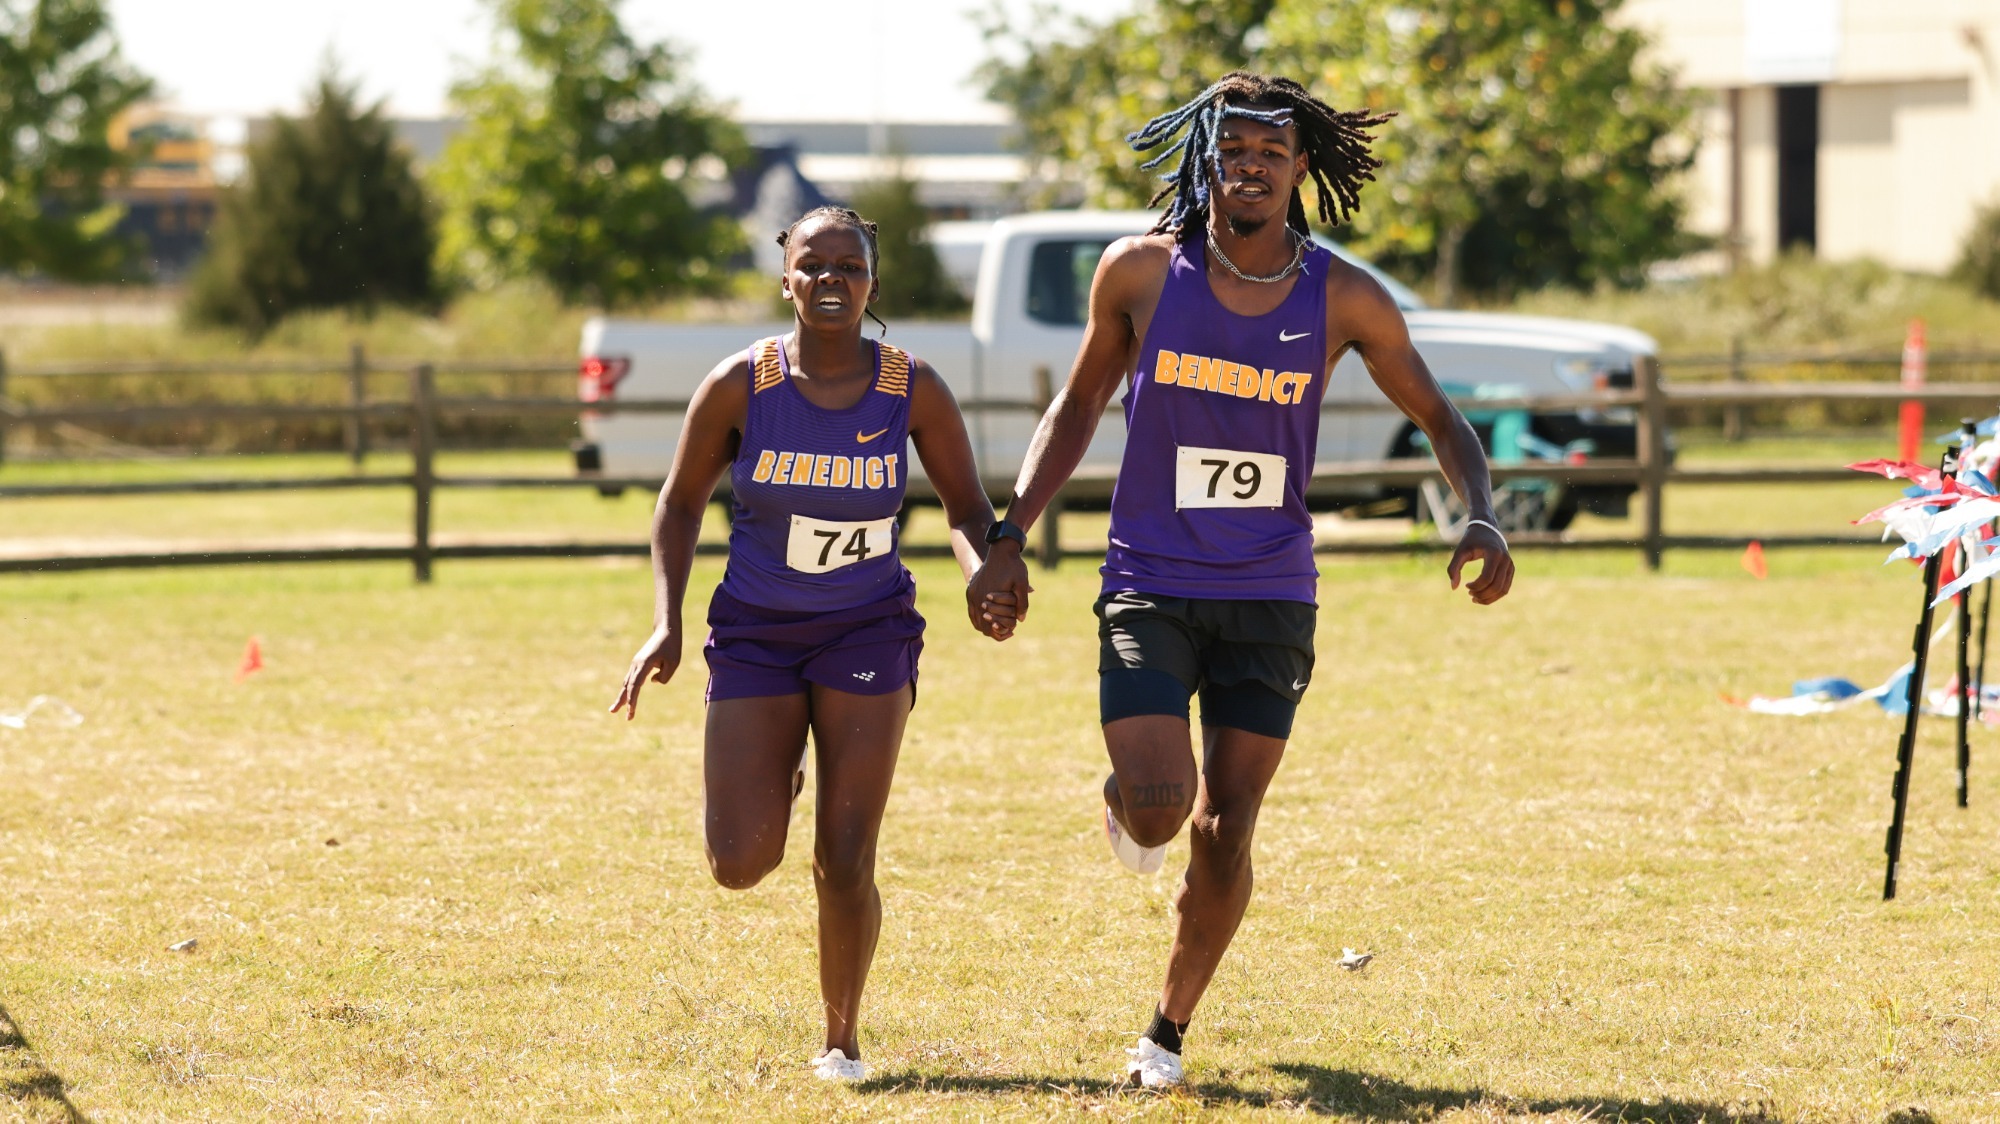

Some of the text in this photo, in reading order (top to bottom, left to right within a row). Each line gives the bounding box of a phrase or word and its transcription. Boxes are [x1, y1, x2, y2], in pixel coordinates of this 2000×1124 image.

[1154, 349, 1312, 405] BENEDICT
[752, 450, 898, 490] BENEDICT
[1200, 459, 1262, 500] 79
[814, 527, 871, 566] 74
[1132, 781, 1186, 809] 2005
